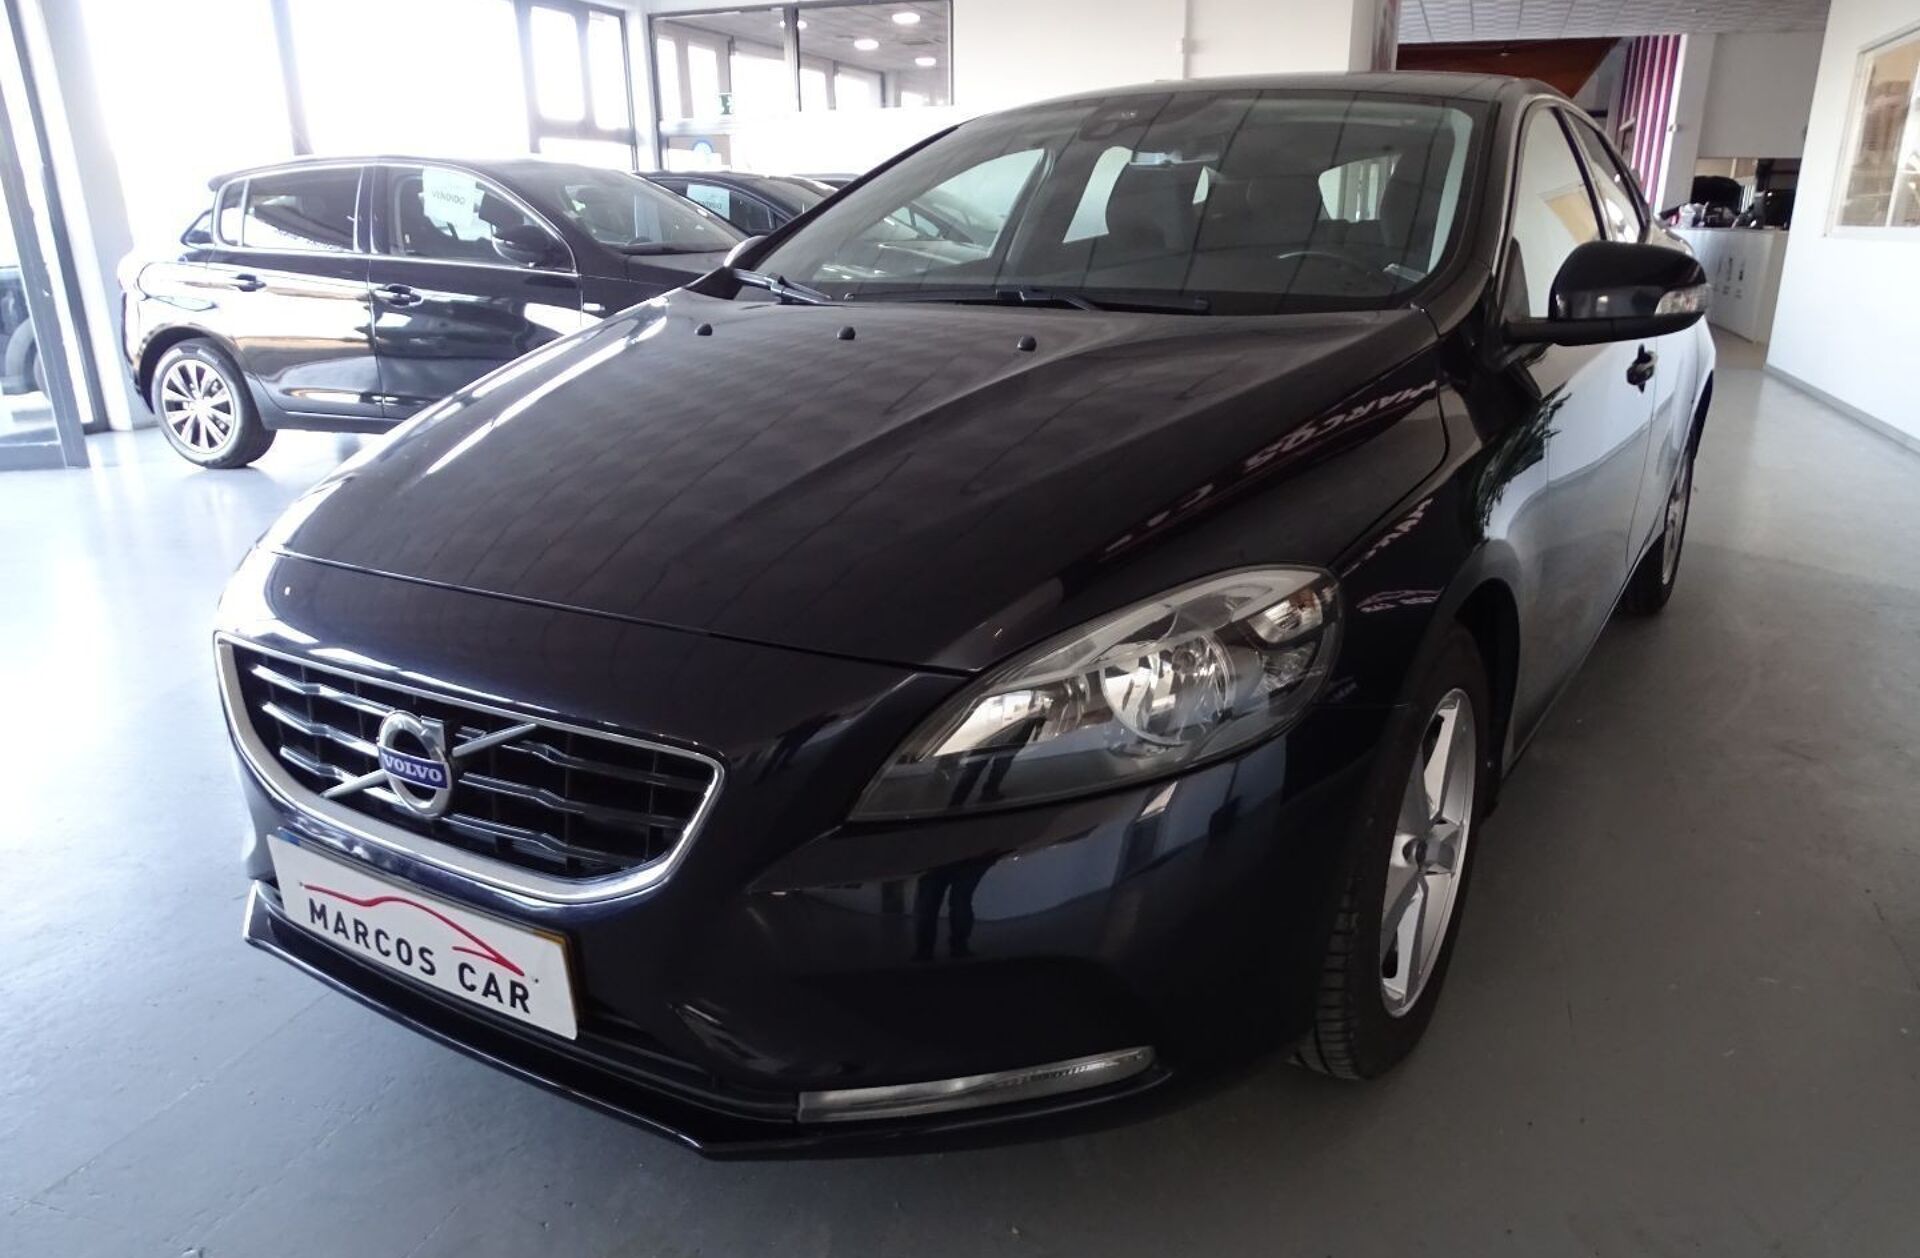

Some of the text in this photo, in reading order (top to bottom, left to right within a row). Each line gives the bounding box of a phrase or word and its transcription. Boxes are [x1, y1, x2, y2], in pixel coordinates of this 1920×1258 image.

[381, 752, 443, 782] VOLVO
[308, 897, 531, 1015] MARCOS CAR
